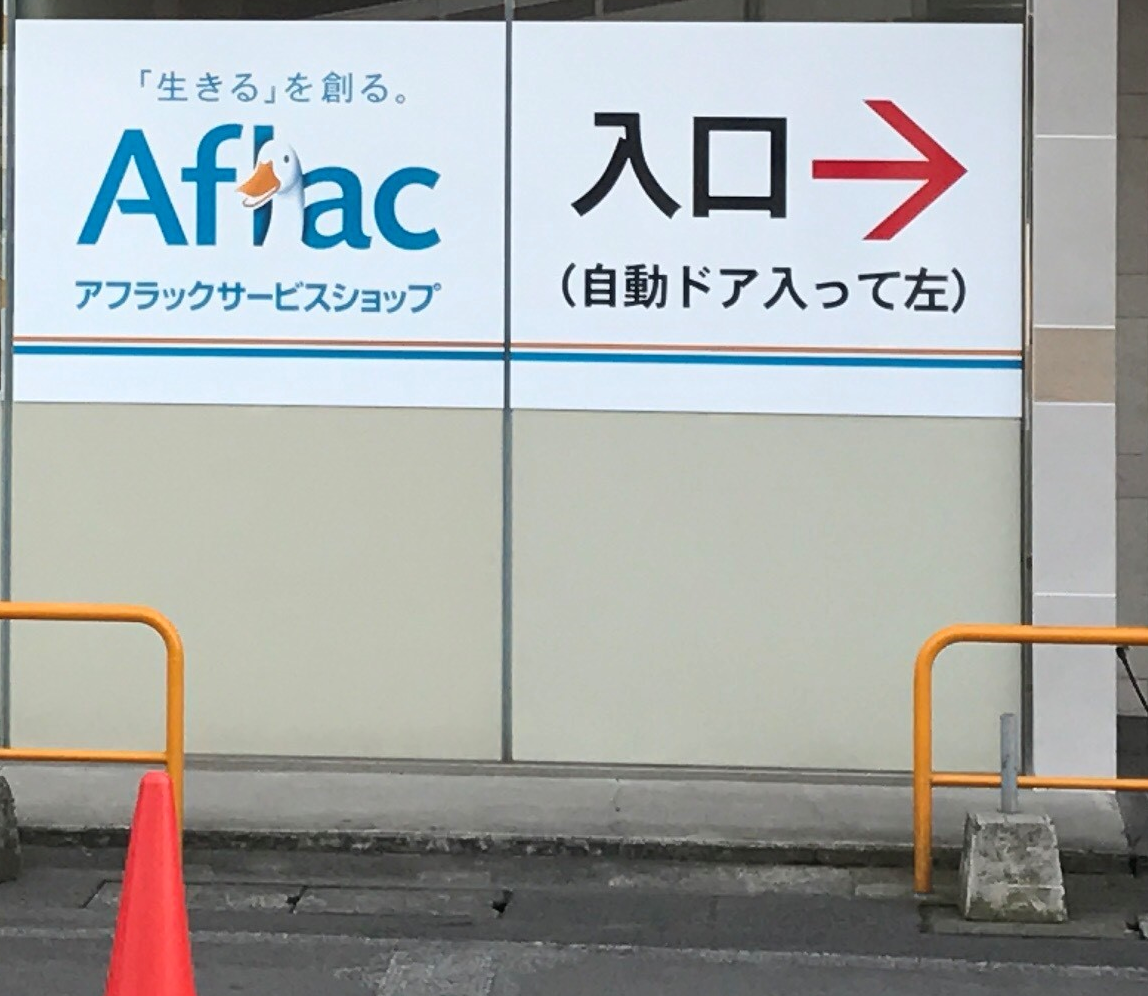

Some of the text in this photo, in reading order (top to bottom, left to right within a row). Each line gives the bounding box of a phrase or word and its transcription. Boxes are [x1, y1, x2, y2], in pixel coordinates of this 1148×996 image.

[140, 68, 407, 105] 「生きる」を創る。
[76, 123, 442, 251] Aflac
[570, 111, 788, 220] 入口
[75, 279, 442, 315] アフラックサービスショップ
[561, 261, 967, 315] (自動ドア入って左)
